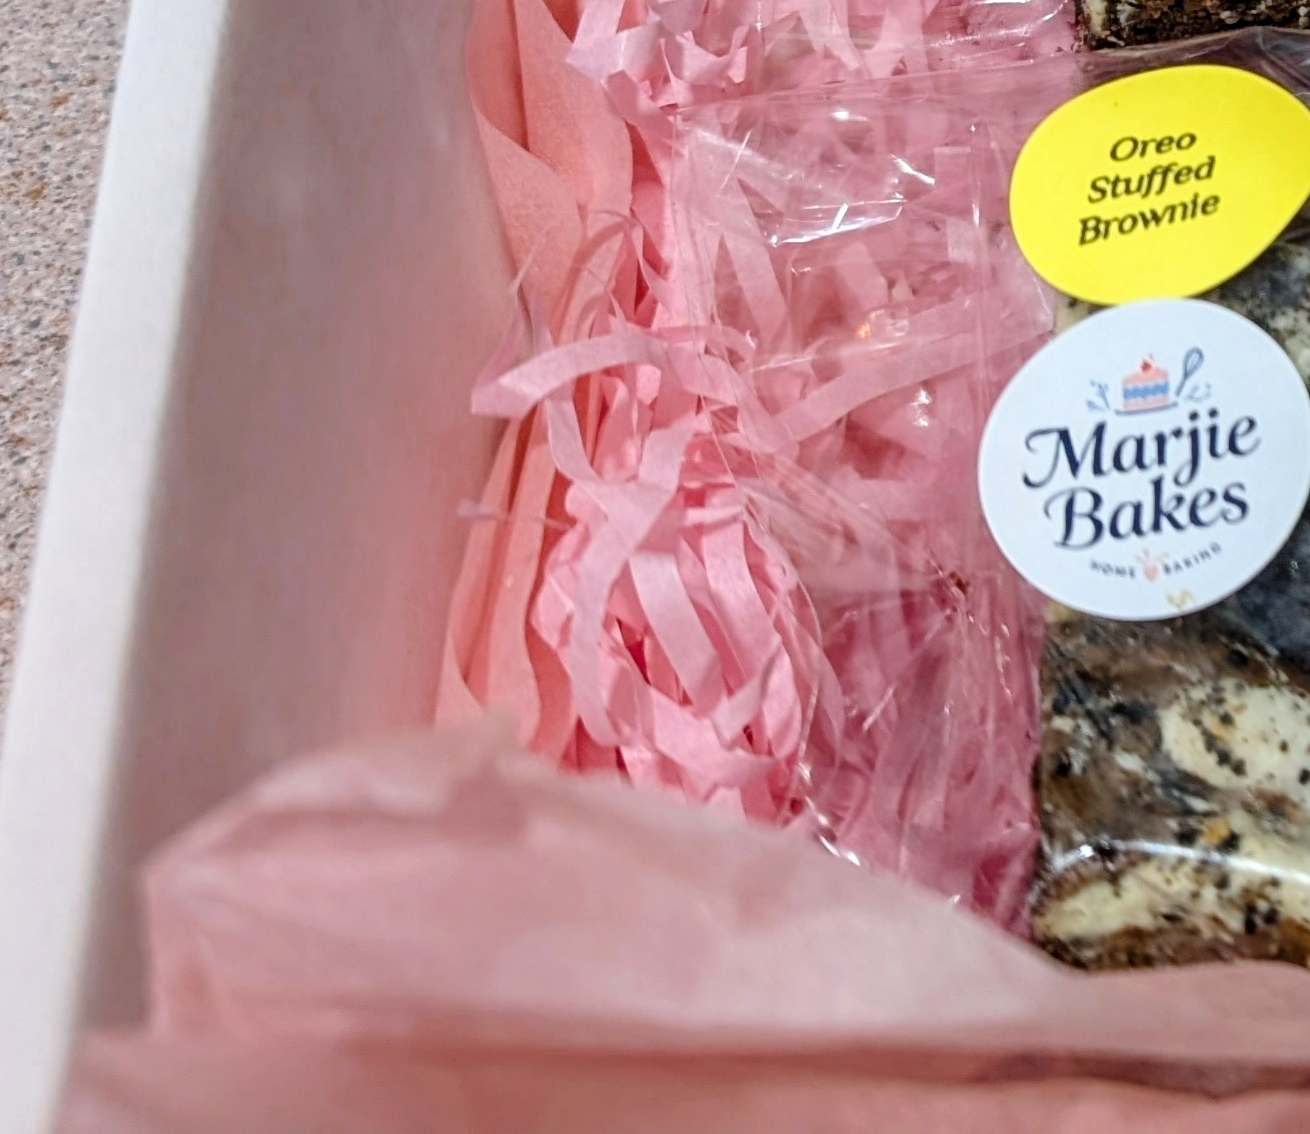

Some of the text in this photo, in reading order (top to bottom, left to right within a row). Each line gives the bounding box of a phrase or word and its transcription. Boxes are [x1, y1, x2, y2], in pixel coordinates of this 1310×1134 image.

[1109, 132, 1197, 162] Oreo
[1087, 155, 1216, 204] Stuffed
[1077, 193, 1221, 246] Brownie
[1022, 407, 1262, 490] Marjie
[1043, 472, 1250, 551] Bakes
